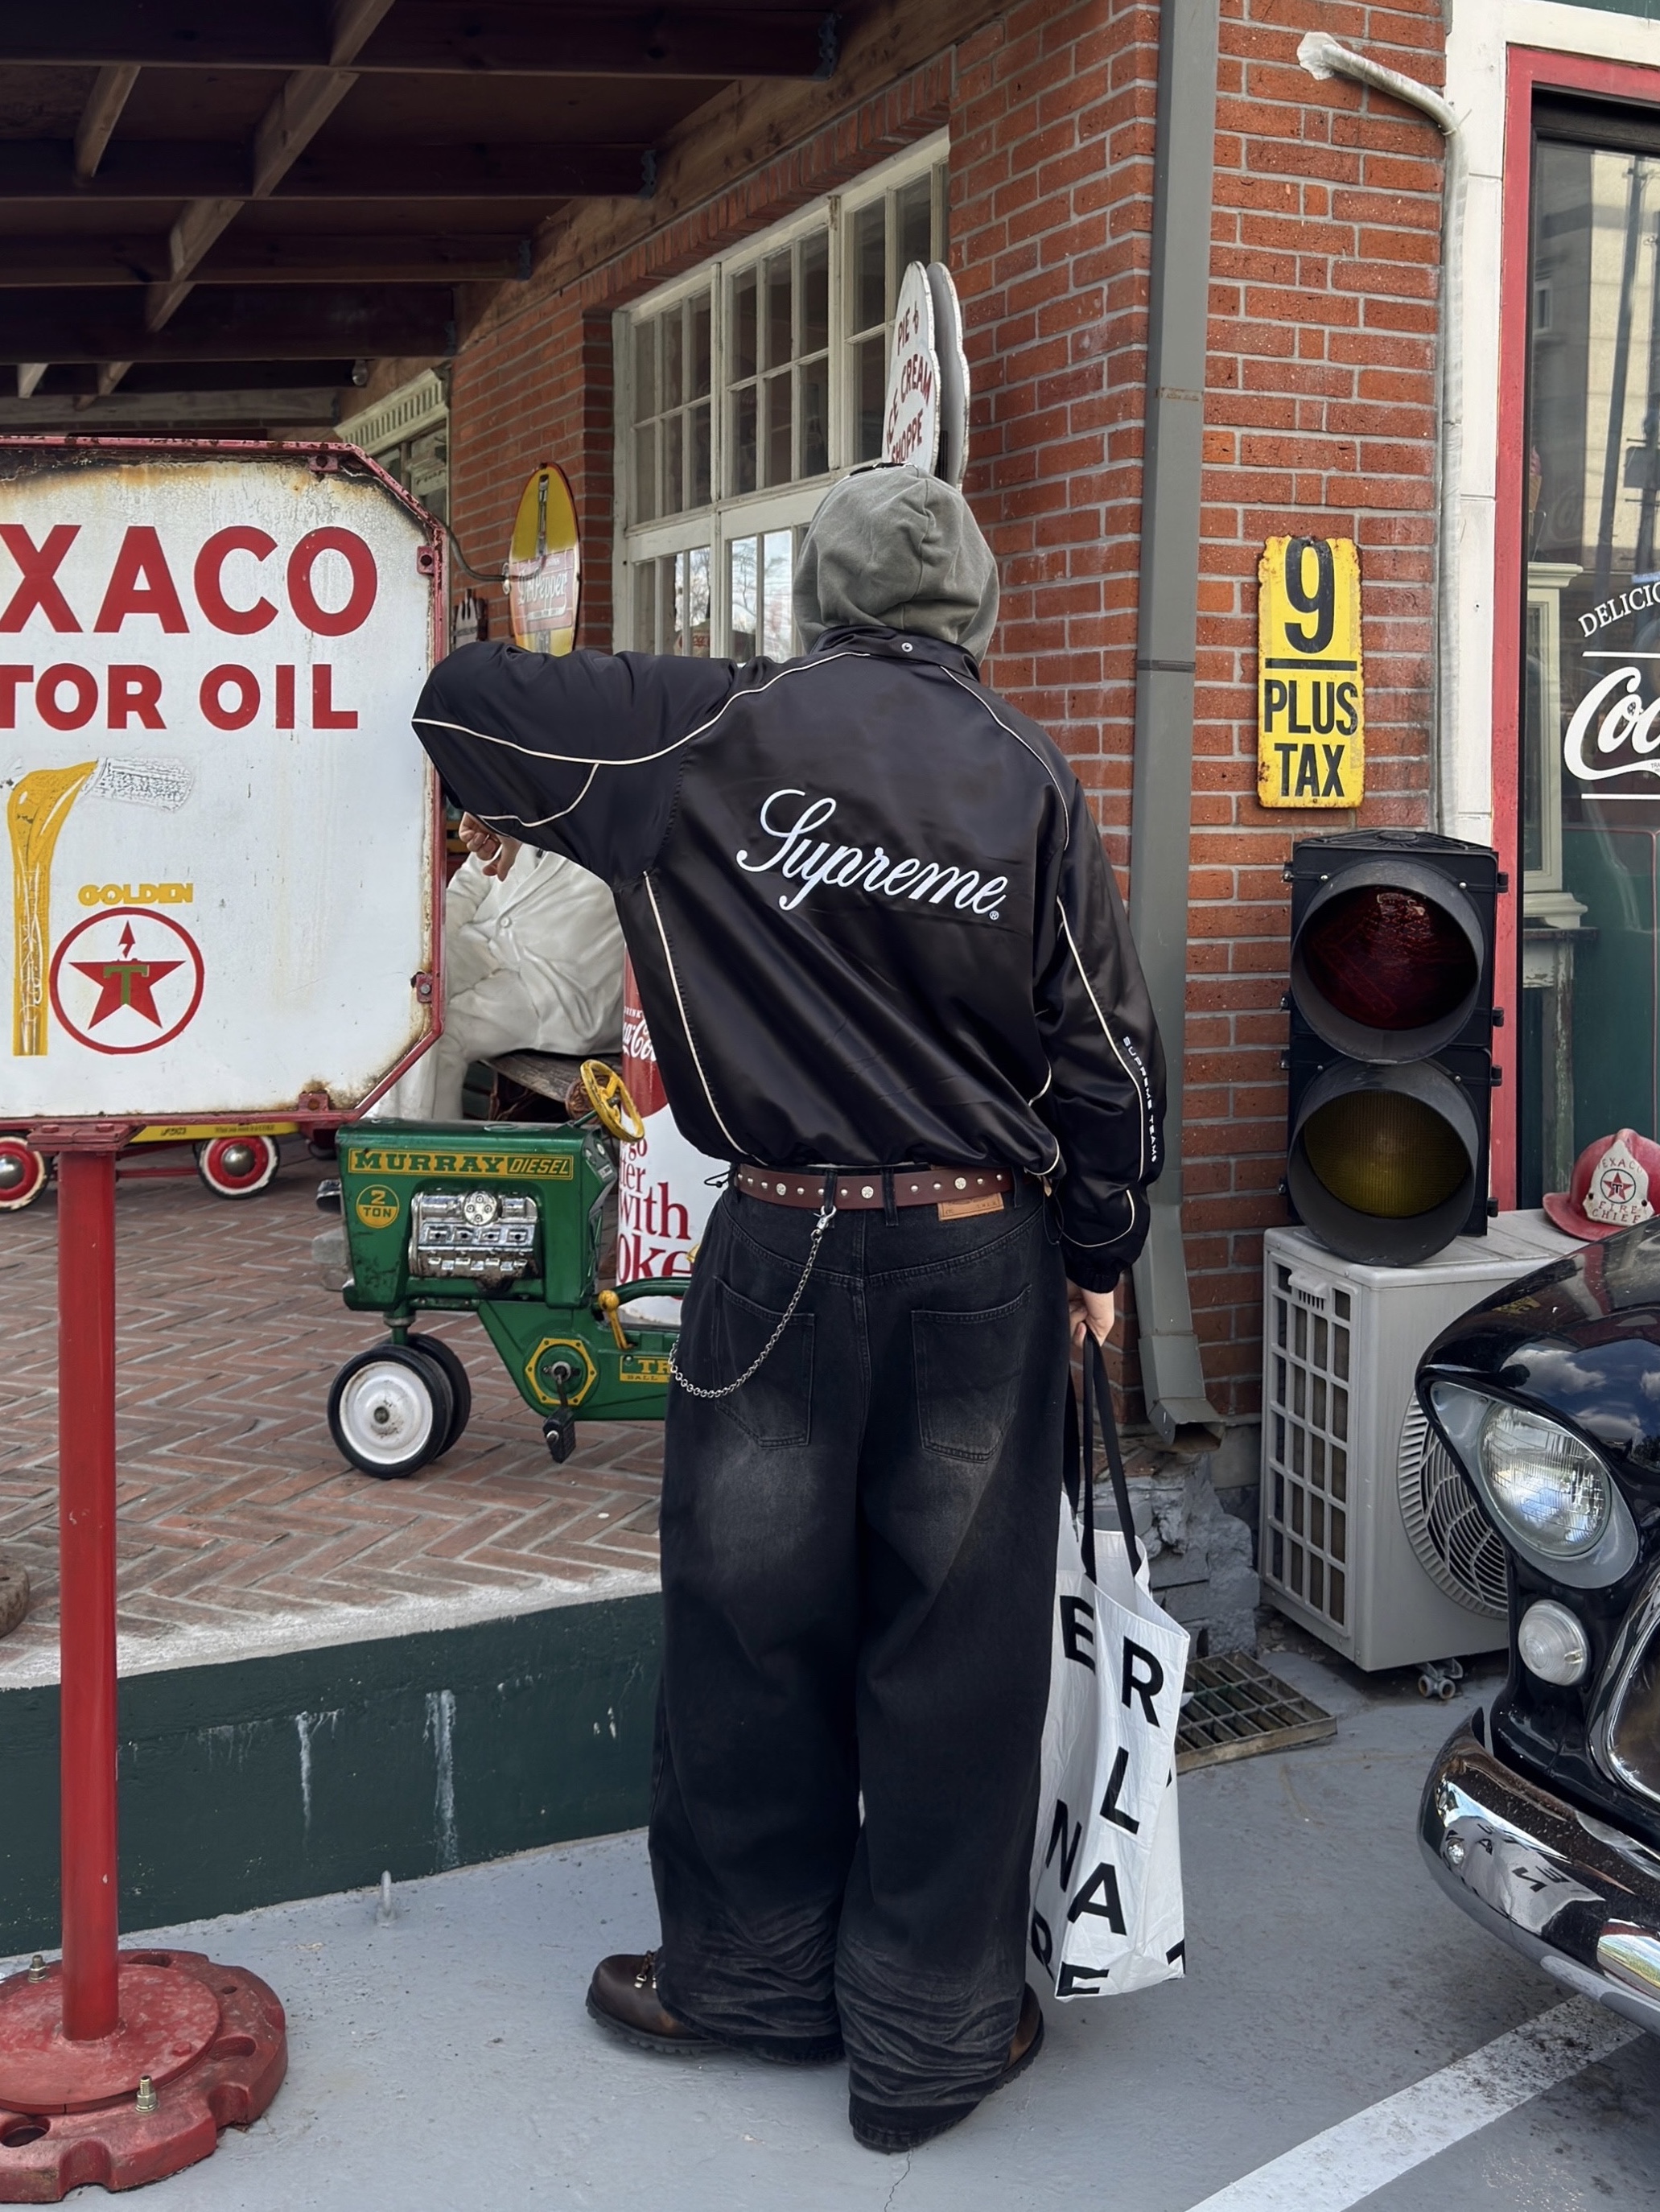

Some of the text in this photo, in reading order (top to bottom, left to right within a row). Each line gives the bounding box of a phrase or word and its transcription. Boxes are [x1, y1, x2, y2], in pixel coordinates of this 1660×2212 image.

[897, 307, 911, 356] PIE
[886, 353, 933, 454] ICE CREAM
[0, 524, 378, 637] XACO
[1284, 534, 1334, 654] 9
[200, 664, 359, 731] OIL
[1264, 679, 1358, 736] PLUS
[1275, 743, 1345, 797] TAX
[78, 884, 193, 906] GOLDEN
[1122, 1036, 1153, 1110] SUPREME
[355, 1152, 570, 1176] MURRAY DIESEL
[363, 1207, 392, 1217] TON
[371, 1190, 385, 1205] 2
[620, 1182, 692, 1241] with
[1592, 1209, 1641, 1224] CHIEF
[1600, 1201, 1637, 1214] FIRE
[1060, 1595, 1096, 1674] E
[1121, 1636, 1164, 1728] R
[1100, 1746, 1139, 1835] L
[1047, 1799, 1082, 1892] N
[1067, 1862, 1127, 1936] A
